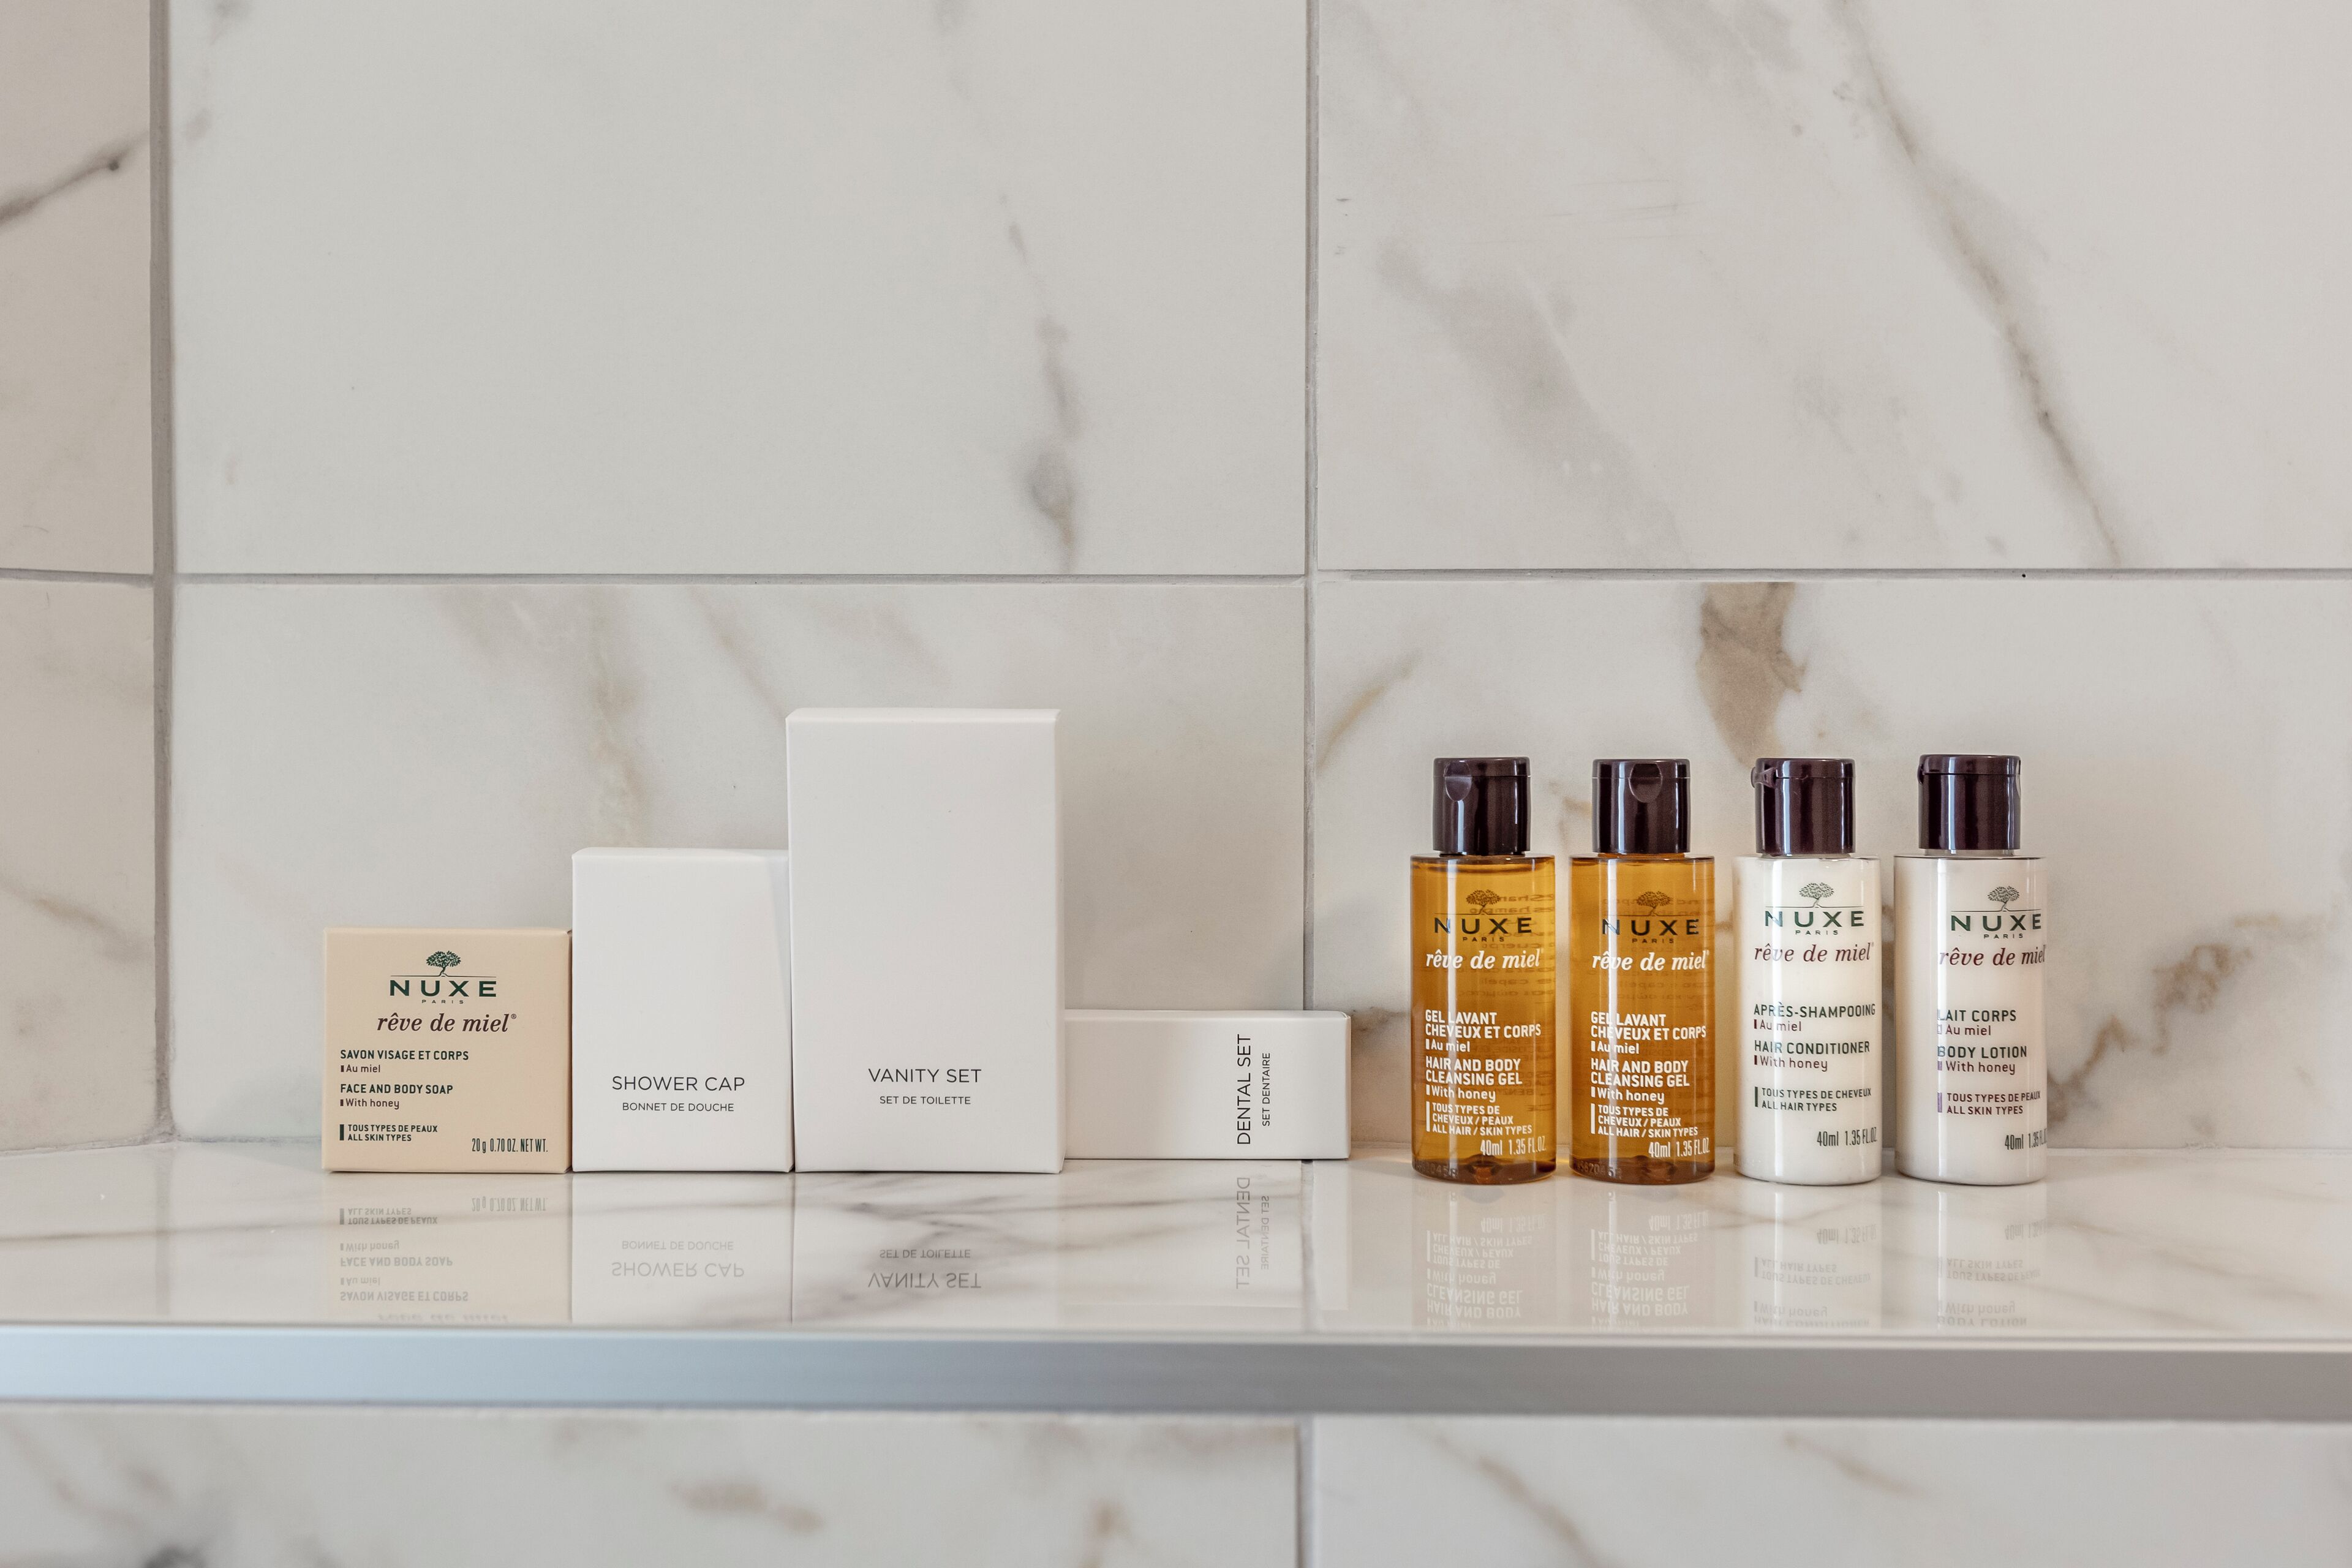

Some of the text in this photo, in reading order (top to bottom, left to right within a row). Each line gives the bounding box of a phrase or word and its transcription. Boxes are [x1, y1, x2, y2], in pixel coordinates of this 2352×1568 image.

[1434, 917, 1532, 935] NUXE
[1765, 910, 1864, 927] NUXE
[1950, 913, 2041, 932] NUXE
[1602, 919, 1699, 936] NUXE
[1426, 949, 1463, 968] rêve
[1470, 950, 1496, 970] de
[1754, 943, 1795, 962] rêve
[1803, 944, 1828, 962] de
[1939, 947, 1985, 966] rêve
[1992, 948, 2016, 966] de
[1592, 951, 1634, 971] rêve
[1640, 952, 1666, 971] de
[390, 979, 497, 998] NUXE
[1425, 1009, 1498, 1025] GEL LAVANT
[1754, 1001, 1875, 1018] APRÈS-SHAMPOOING
[1937, 1009, 2017, 1022] LAIT CORPS
[377, 1012, 423, 1032] rêve
[429, 1012, 454, 1031] de
[1591, 1011, 1667, 1027] GEL LAVANT
[1760, 1019, 1802, 1031] Au miel
[1425, 1023, 1542, 1039] CHEVEUX ET CORPS
[1591, 1025, 1706, 1041] CHEVEUX ET CORPS
[1945, 1024, 1991, 1036] Au miel
[1431, 1039, 1471, 1052] Au miel
[1597, 1041, 1640, 1055] Au miel
[1754, 1039, 1870, 1055] HAIR CONDITIONER
[1937, 1046, 2027, 1059] BODY LOTION
[340, 1049, 469, 1061] SAVON VISAGE ET CORPS
[345, 1064, 381, 1073] Au miel
[1426, 1055, 1521, 1072] HAIR AND BODY
[1591, 1057, 1689, 1074] HAIR AND BODY
[1760, 1055, 1828, 1072] With honey
[1945, 1060, 2016, 1076] With honey
[612, 1076, 745, 1091] SHOWER CAP
[868, 1068, 982, 1083] VANITY SET
[1426, 1069, 1523, 1086] CLEANSING GEL
[1591, 1071, 1690, 1088] CLEANSING GEL
[340, 1084, 453, 1095] FACE AND BODY SOAP
[1237, 1033, 1251, 1145] DENTAL SET
[1261, 1052, 1271, 1126] SET DENTAIRE
[1431, 1085, 1455, 1098] With
[1458, 1087, 1496, 1103] honey
[1597, 1087, 1665, 1106] With honey
[1762, 1087, 1872, 1099] TOUS TYPES DE CHEVEUX
[1947, 1091, 2041, 1102] TOUS TYPES DE PEAUX
[345, 1098, 400, 1110] With honey
[622, 1102, 734, 1112] BONNET DE DOUCHE
[879, 1096, 971, 1105] SET DE TOILETTE
[1432, 1102, 1500, 1115] TOUS TYPES DE
[1762, 1100, 1838, 1112] ALL HAIR TYPES
[1598, 1104, 1668, 1117] TOUS TYPES DE
[1947, 1105, 2024, 1115] ALL SKIN TYPES
[1432, 1114, 1473, 1125] CHEVEUX
[1482, 1115, 1514, 1125] PEAUX
[1597, 1115, 1642, 1128] CHEVEUX
[1650, 1117, 1681, 1128] PEAUX
[1432, 1124, 1447, 1134] ALL
[1449, 1125, 1471, 1136] HAIR
[1480, 1126, 1503, 1136] SKIN
[1505, 1125, 1532, 1136] TYPES
[1597, 1126, 1615, 1136] ALL
[1616, 1127, 1640, 1138] HAIR
[1648, 1128, 1671, 1138] SKIN
[1673, 1126, 1698, 1137] TYPES
[1816, 1131, 1839, 1147] 40ml
[1844, 1129, 1861, 1146] 1.35
[489, 1138, 505, 1152] 0.70
[520, 1138, 533, 1152] NET
[535, 1138, 548, 1153] WT.
[1480, 1139, 1502, 1156] 40ml
[1508, 1138, 1526, 1155] 1.35
[1648, 1141, 1671, 1158] 40ml
[1676, 1140, 1692, 1157] 1.35
[2005, 1134, 2024, 1150] 40ml
